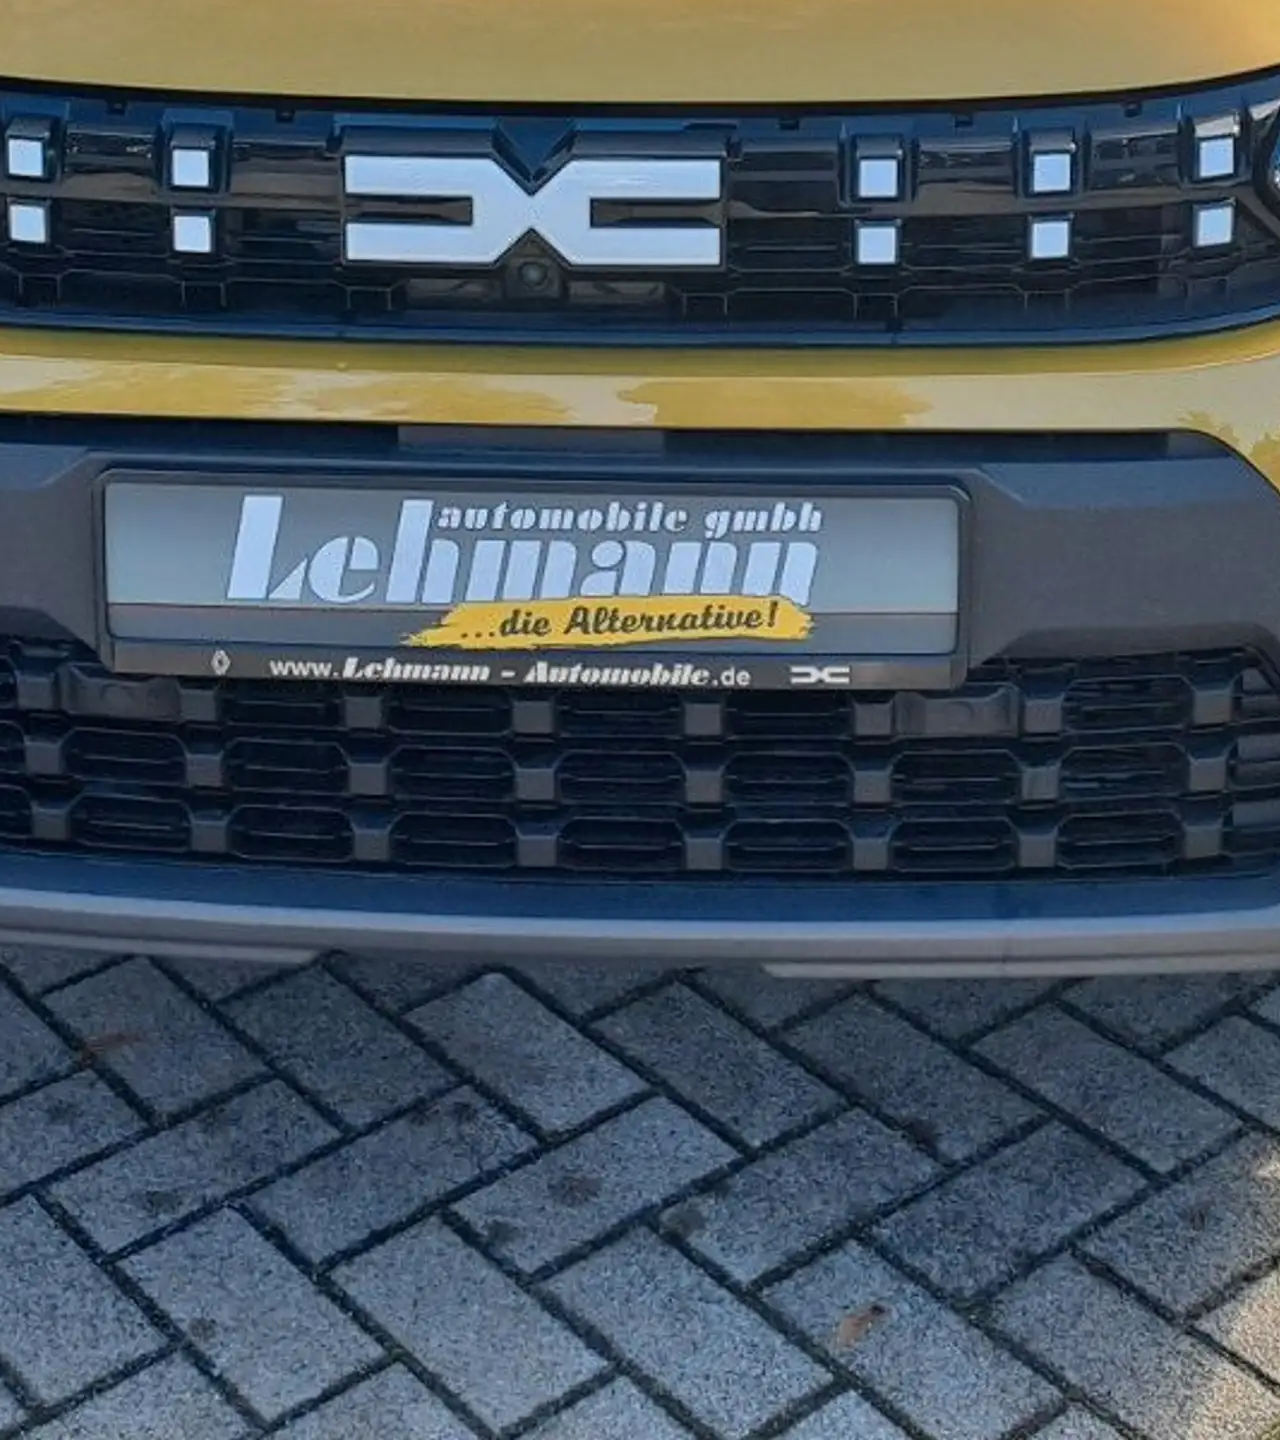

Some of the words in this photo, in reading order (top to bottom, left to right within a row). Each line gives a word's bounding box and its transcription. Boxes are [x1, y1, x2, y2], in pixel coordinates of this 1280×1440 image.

[436, 501, 689, 533] automobile
[704, 501, 824, 539] gmbh
[226, 495, 818, 607] Lehmann
[562, 600, 780, 636] Alternative!
[269, 656, 491, 682] www.Lehmann
[522, 660, 752, 687] Automobile.de
